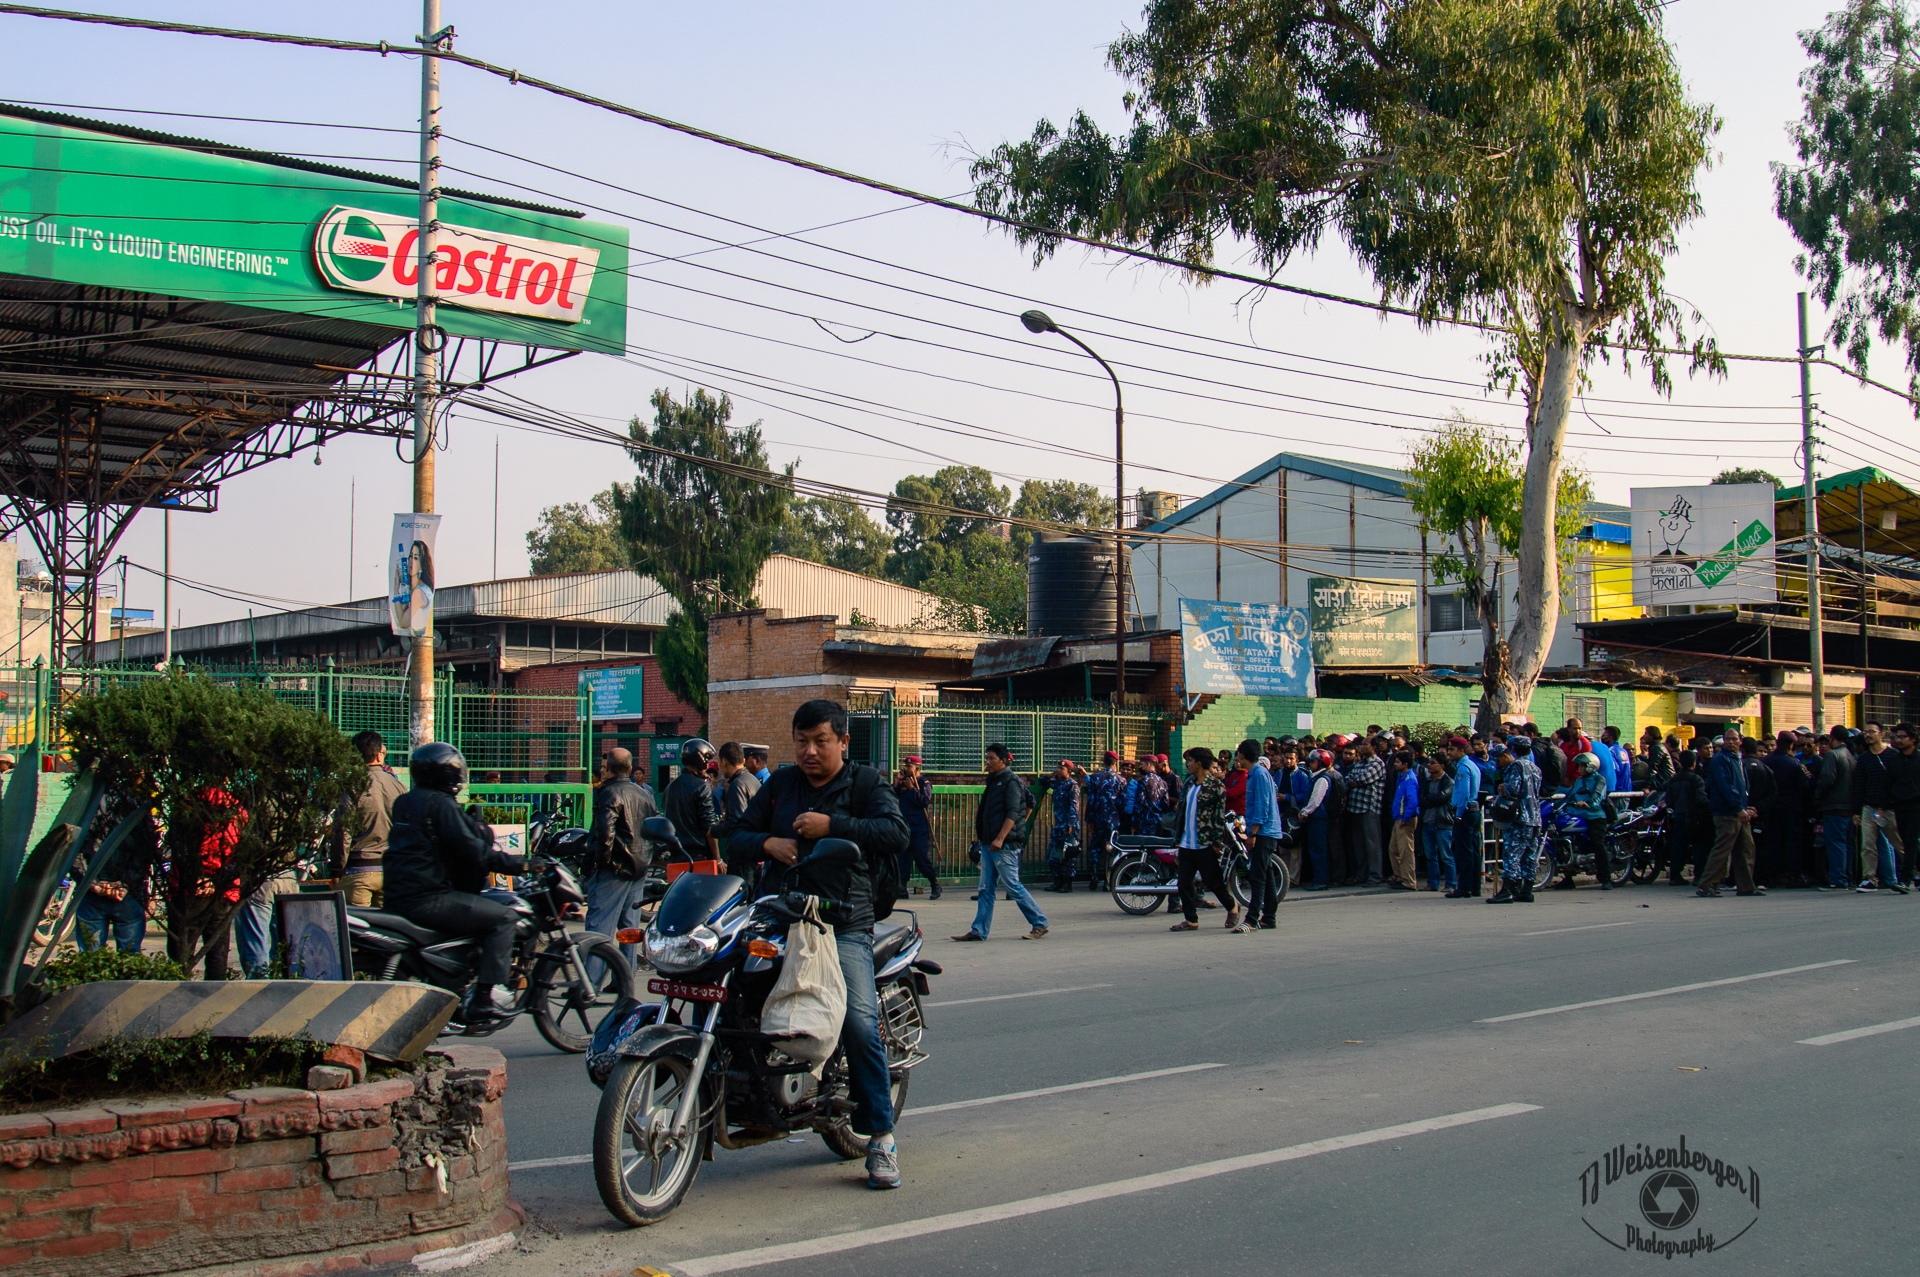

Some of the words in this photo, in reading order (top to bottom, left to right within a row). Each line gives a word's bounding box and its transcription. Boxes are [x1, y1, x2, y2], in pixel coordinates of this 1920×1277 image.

[36, 221, 65, 246] OIL.
[71, 226, 104, 251] IT'S
[109, 232, 163, 260] LIQUID
[392, 229, 579, 310] Castrol
[1349, 583, 1384, 612] पेट्रोल
[1387, 590, 1412, 610] पम्प
[1211, 646, 1239, 655] SAJHA
[609, 668, 641, 677] यातायात
